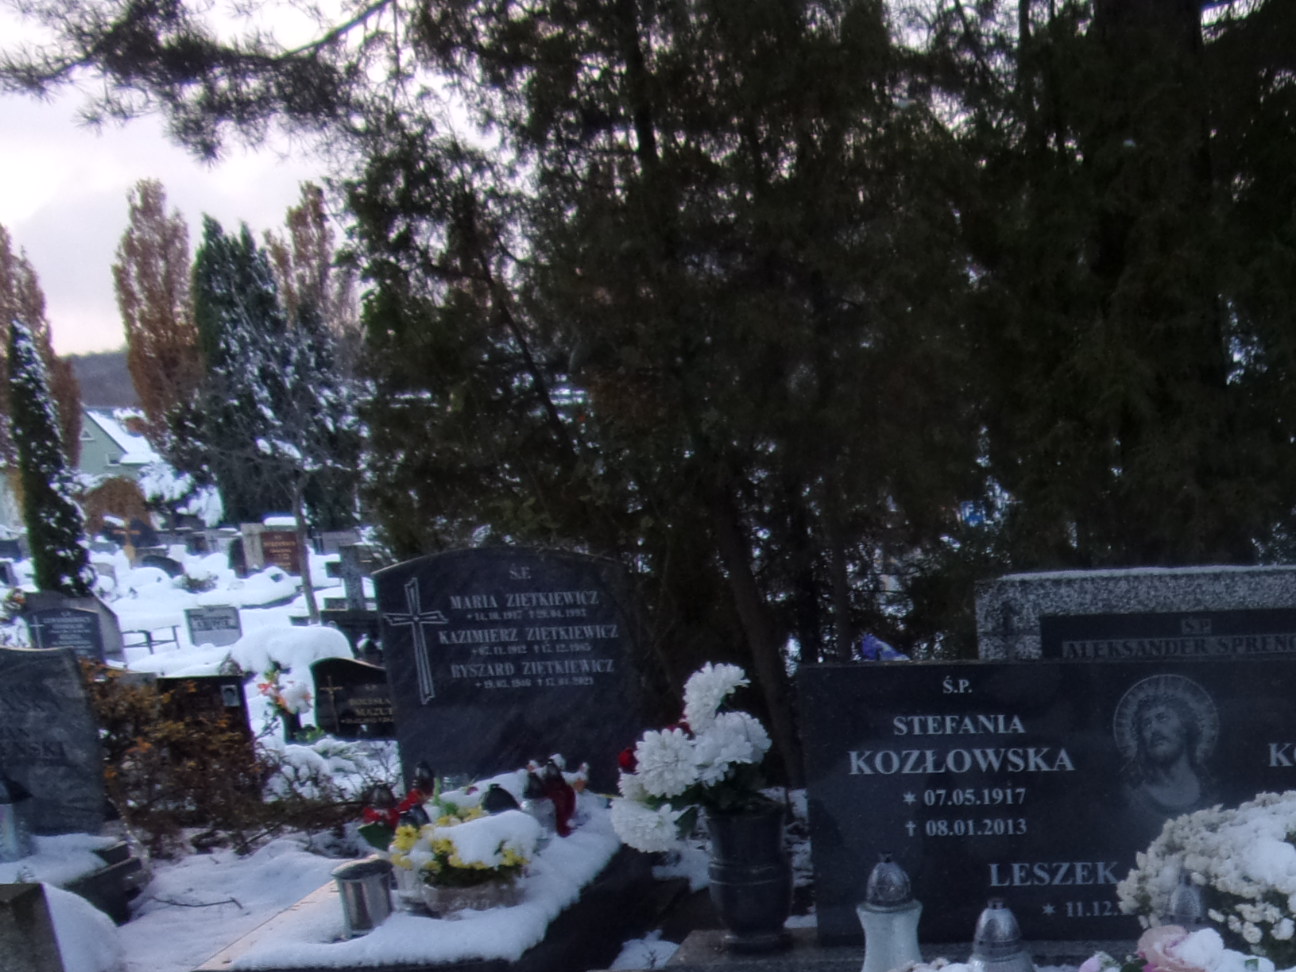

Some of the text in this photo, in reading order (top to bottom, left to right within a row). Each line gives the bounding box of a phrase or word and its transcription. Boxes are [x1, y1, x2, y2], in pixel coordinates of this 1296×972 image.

[450, 595, 498, 609] MARIA
[438, 627, 518, 645] KAZIMIERZ
[1064, 637, 1210, 658] ALEKSANDER
[451, 662, 515, 678] RYSZARD
[942, 675, 973, 694] Ś.P.
[893, 714, 1026, 736] STEFANIA
[848, 748, 1075, 775] KOZŁOWSKA
[924, 788, 1026, 806] 07.05.1917
[925, 818, 1028, 836] 08.01.2013
[988, 861, 1119, 887] LESZEK
